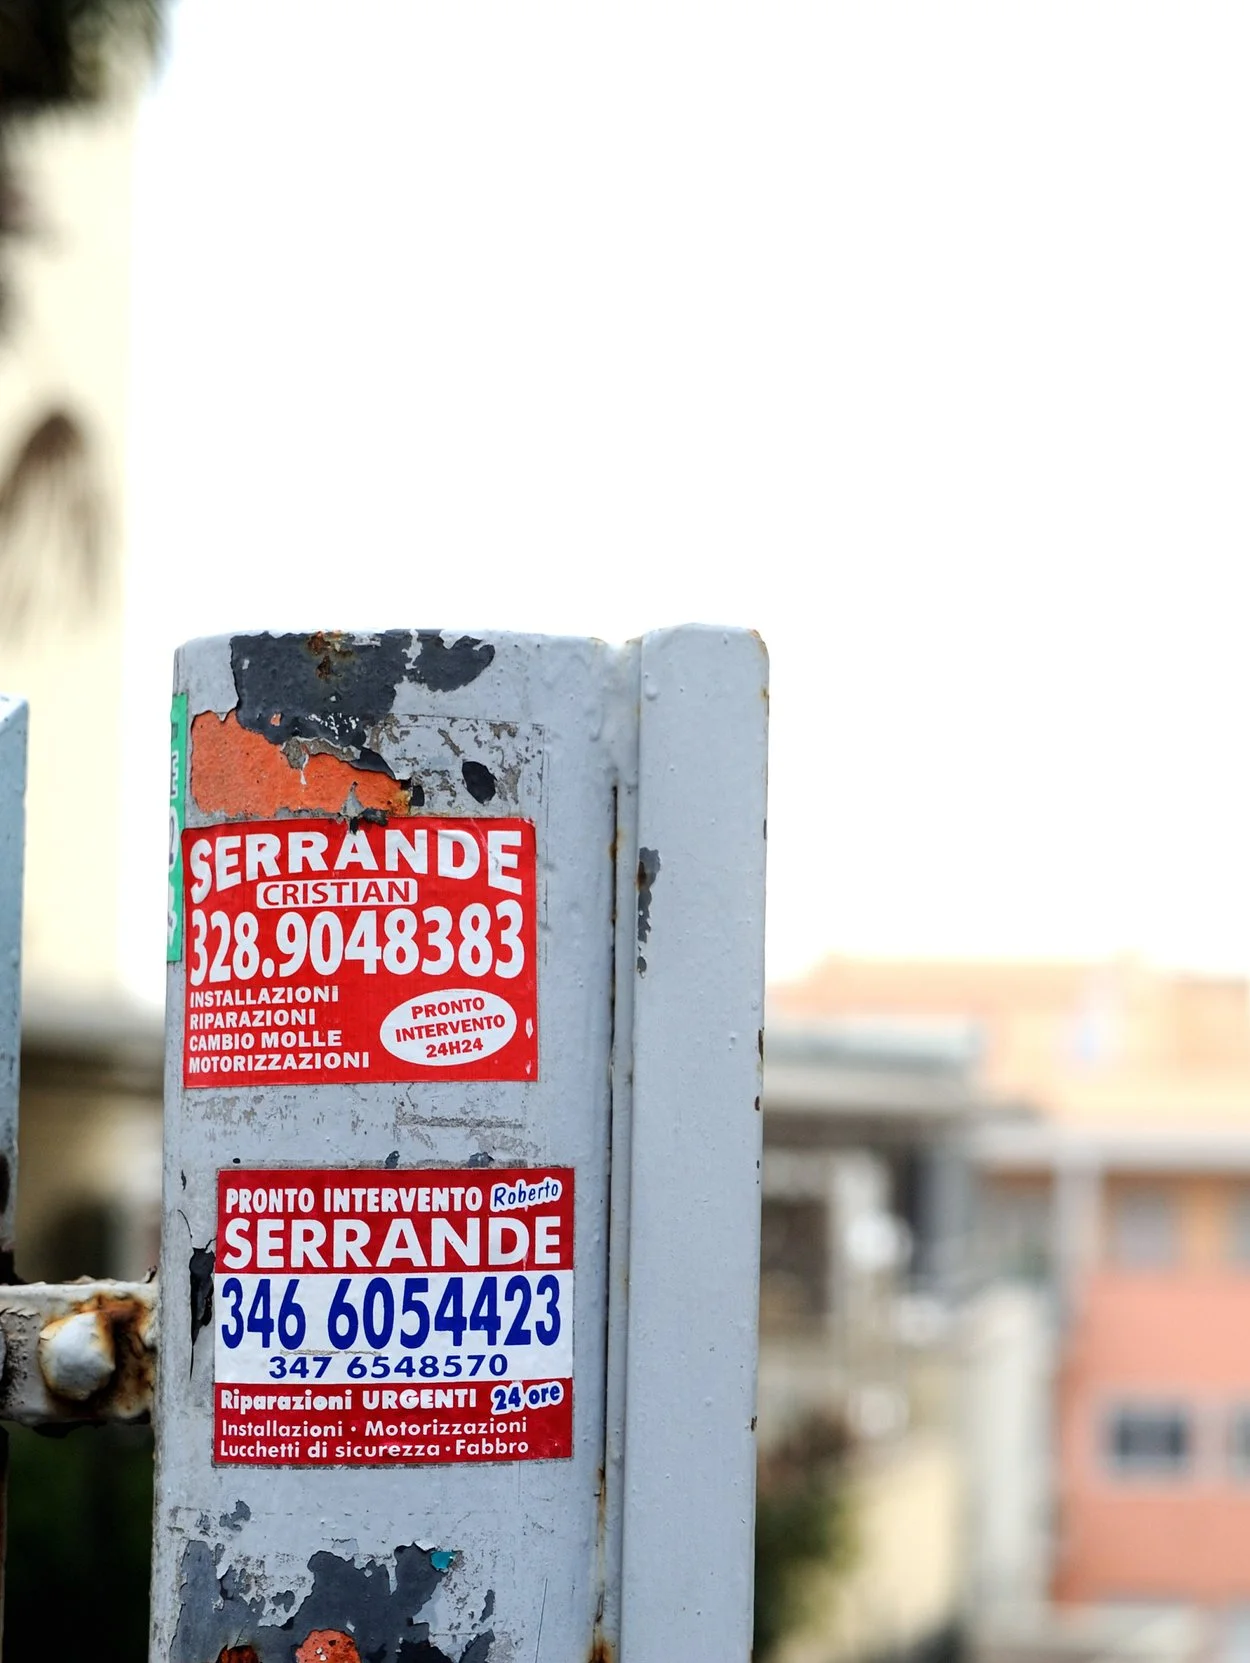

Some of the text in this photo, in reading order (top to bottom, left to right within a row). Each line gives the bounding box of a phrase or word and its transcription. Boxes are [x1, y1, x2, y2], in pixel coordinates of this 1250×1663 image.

[190, 829, 522, 904] SERRANDE
[263, 881, 409, 905] CRISTIAN
[190, 900, 524, 986] 328.9048383
[190, 986, 339, 1008] INSTALLAZIONI
[411, 997, 485, 1019] PRONTO
[189, 1009, 315, 1030] RIPARAZIONI
[396, 1014, 505, 1042] INTERVENTO
[189, 1030, 342, 1051] CAMBIO MOLLE
[426, 1038, 483, 1057] 24H24
[189, 1051, 369, 1073] MOTORIZZAZIONI
[226, 1187, 482, 1213] PRONTO INTERVENTO
[494, 1178, 558, 1208] Roberto
[223, 1216, 561, 1269] SERRANDE
[222, 1275, 560, 1350] 346 6054423
[269, 1354, 507, 1378] 347 6548570
[221, 1389, 476, 1415] Riparazioni URGENTI
[493, 1385, 560, 1411] 24 ore
[222, 1417, 527, 1437] Installazioni Motorizzazioni
[221, 1436, 528, 1458] Lucchetti di sicurezza Fabbro
